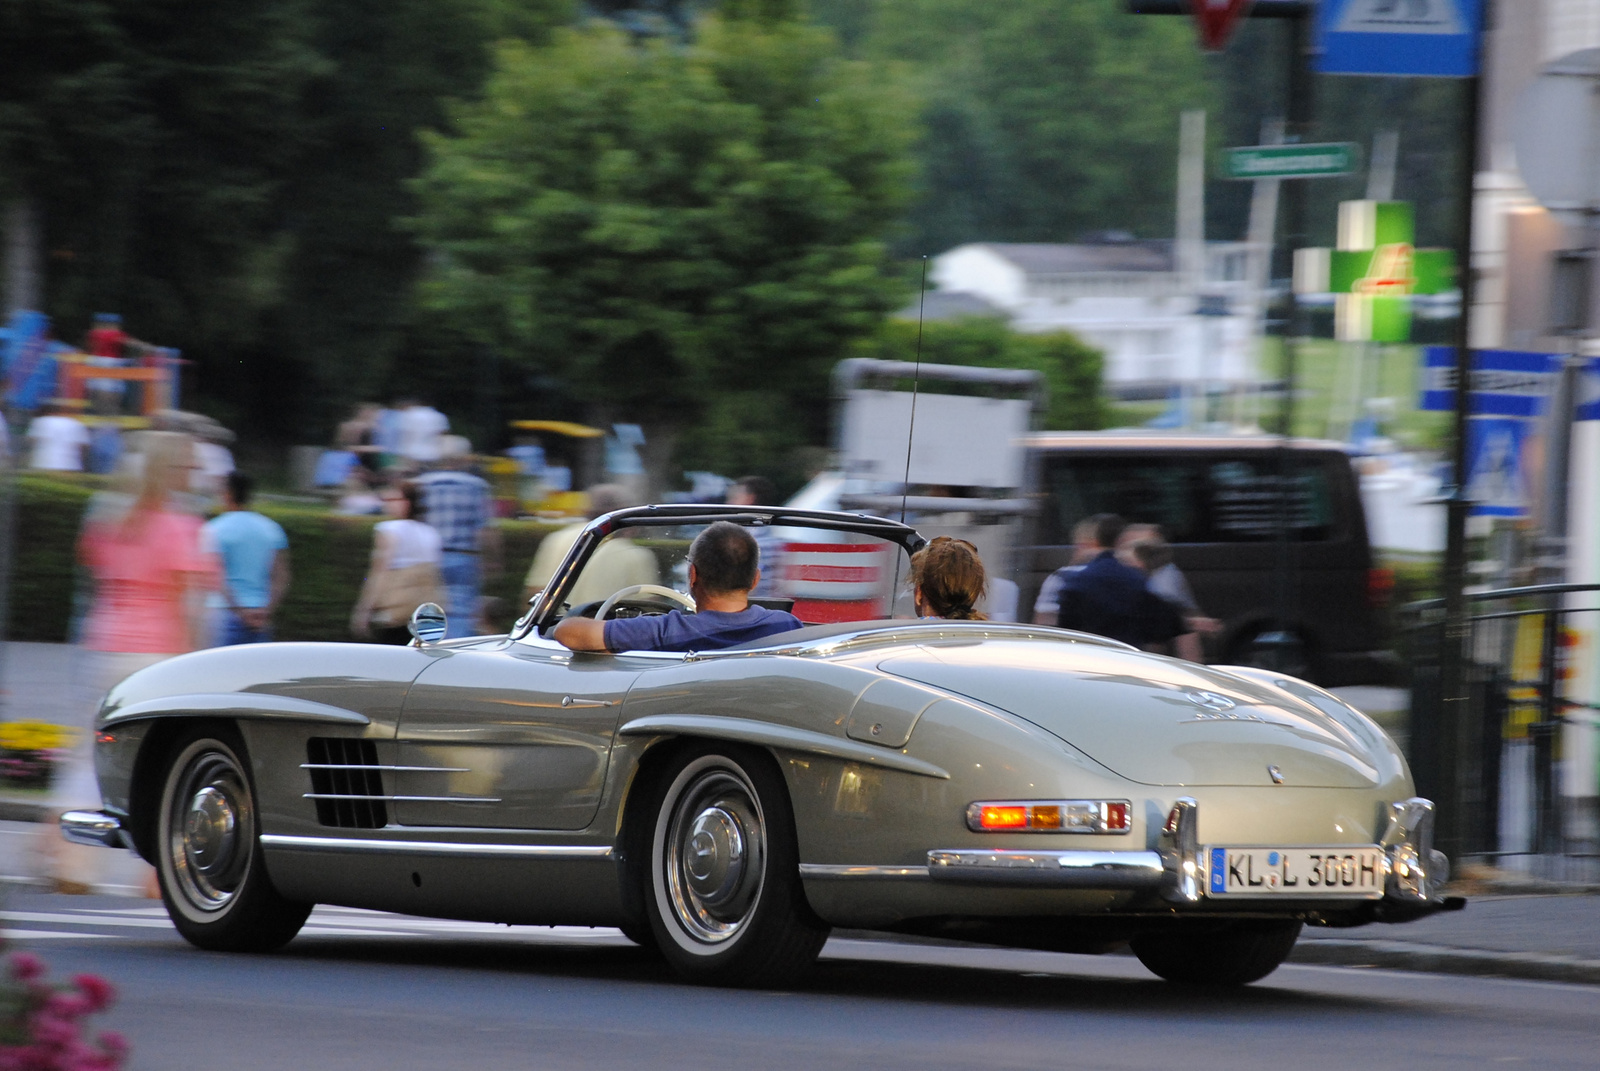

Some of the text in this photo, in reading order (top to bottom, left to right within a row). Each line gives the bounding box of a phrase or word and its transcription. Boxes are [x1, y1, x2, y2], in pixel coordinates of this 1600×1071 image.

[1229, 854, 1376, 887] KL L 300H
